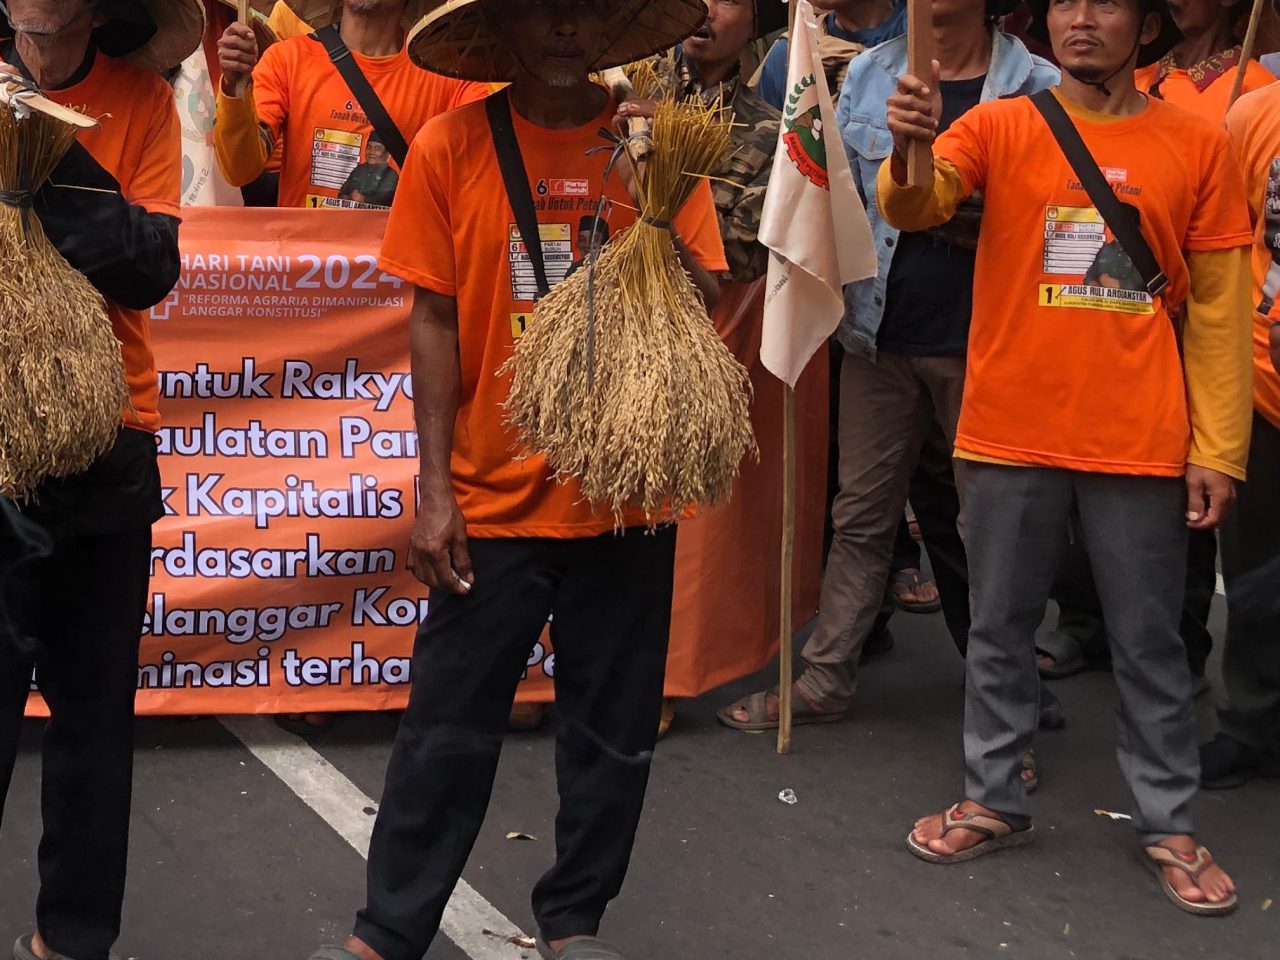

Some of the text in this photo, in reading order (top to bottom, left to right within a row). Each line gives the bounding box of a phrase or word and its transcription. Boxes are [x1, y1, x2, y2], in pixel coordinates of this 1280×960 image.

[345, 100, 353, 110] 6
[536, 179, 548, 195] 6
[511, 243, 518, 252] 6
[236, 255, 291, 272] TANI
[174, 273, 293, 291] NASIONAL
[1045, 287, 1053, 303] 1
[1068, 286, 1087, 296] AGUS
[1090, 287, 1105, 297] RULI
[253, 296, 308, 307] AGRARIA
[312, 297, 404, 308] DIMANIPULASI
[182, 306, 242, 317] LANGGAR
[154, 412, 328, 457] aulatan
[186, 472, 403, 528] Kapitalis
[150, 531, 395, 578] rdasarkan
[282, 642, 412, 686] terha
